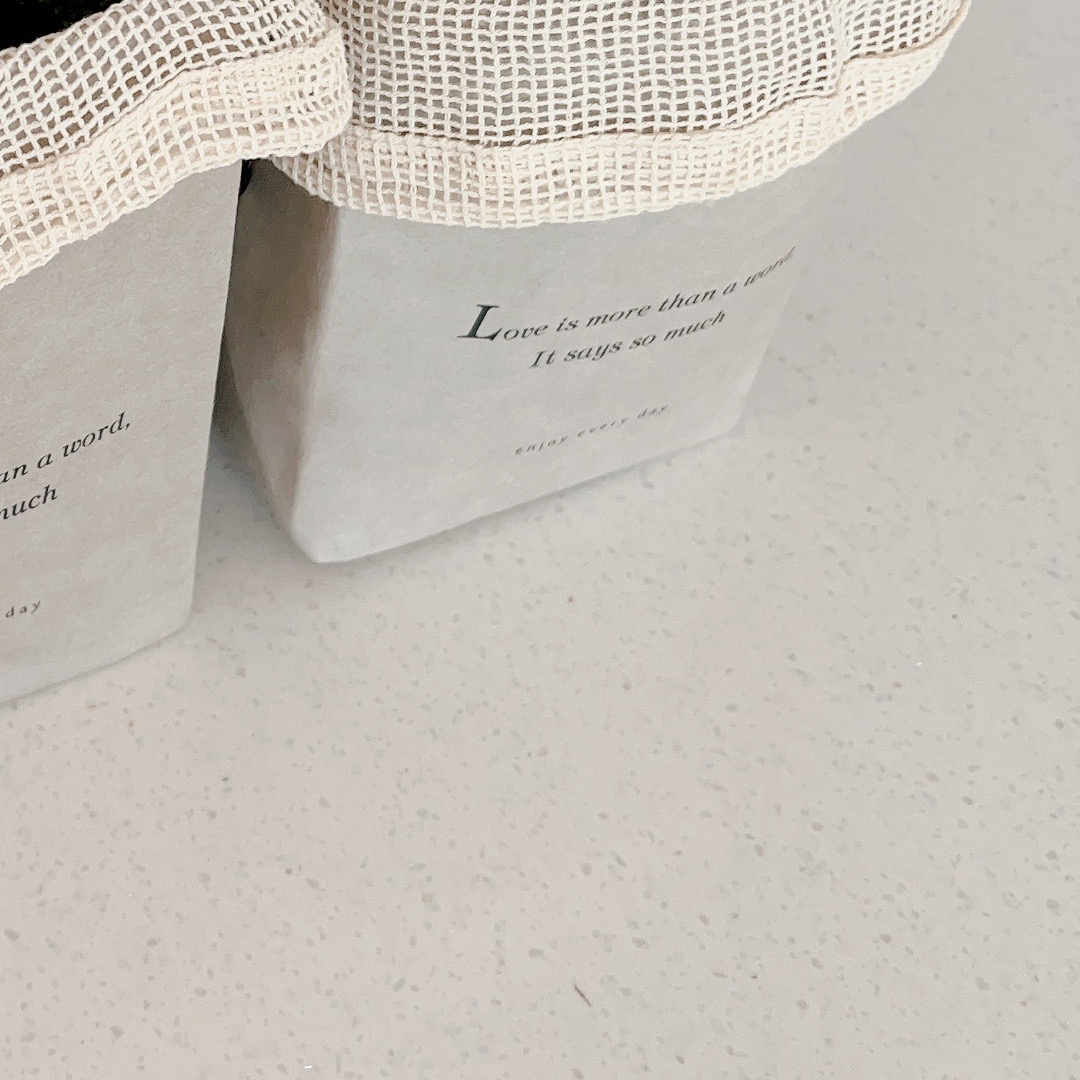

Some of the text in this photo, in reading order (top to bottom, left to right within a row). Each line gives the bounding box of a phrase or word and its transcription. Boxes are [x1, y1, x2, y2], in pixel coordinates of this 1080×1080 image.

[457, 304, 549, 341] Love
[556, 317, 579, 332] is
[587, 305, 652, 326] more
[659, 289, 717, 312] than
[723, 282, 737, 296] a
[529, 310, 726, 368] It says so much
[36, 453, 53, 470] a
[63, 411, 131, 458] word,
[515, 403, 669, 455] enjoy every day
[6, 599, 42, 619] day
